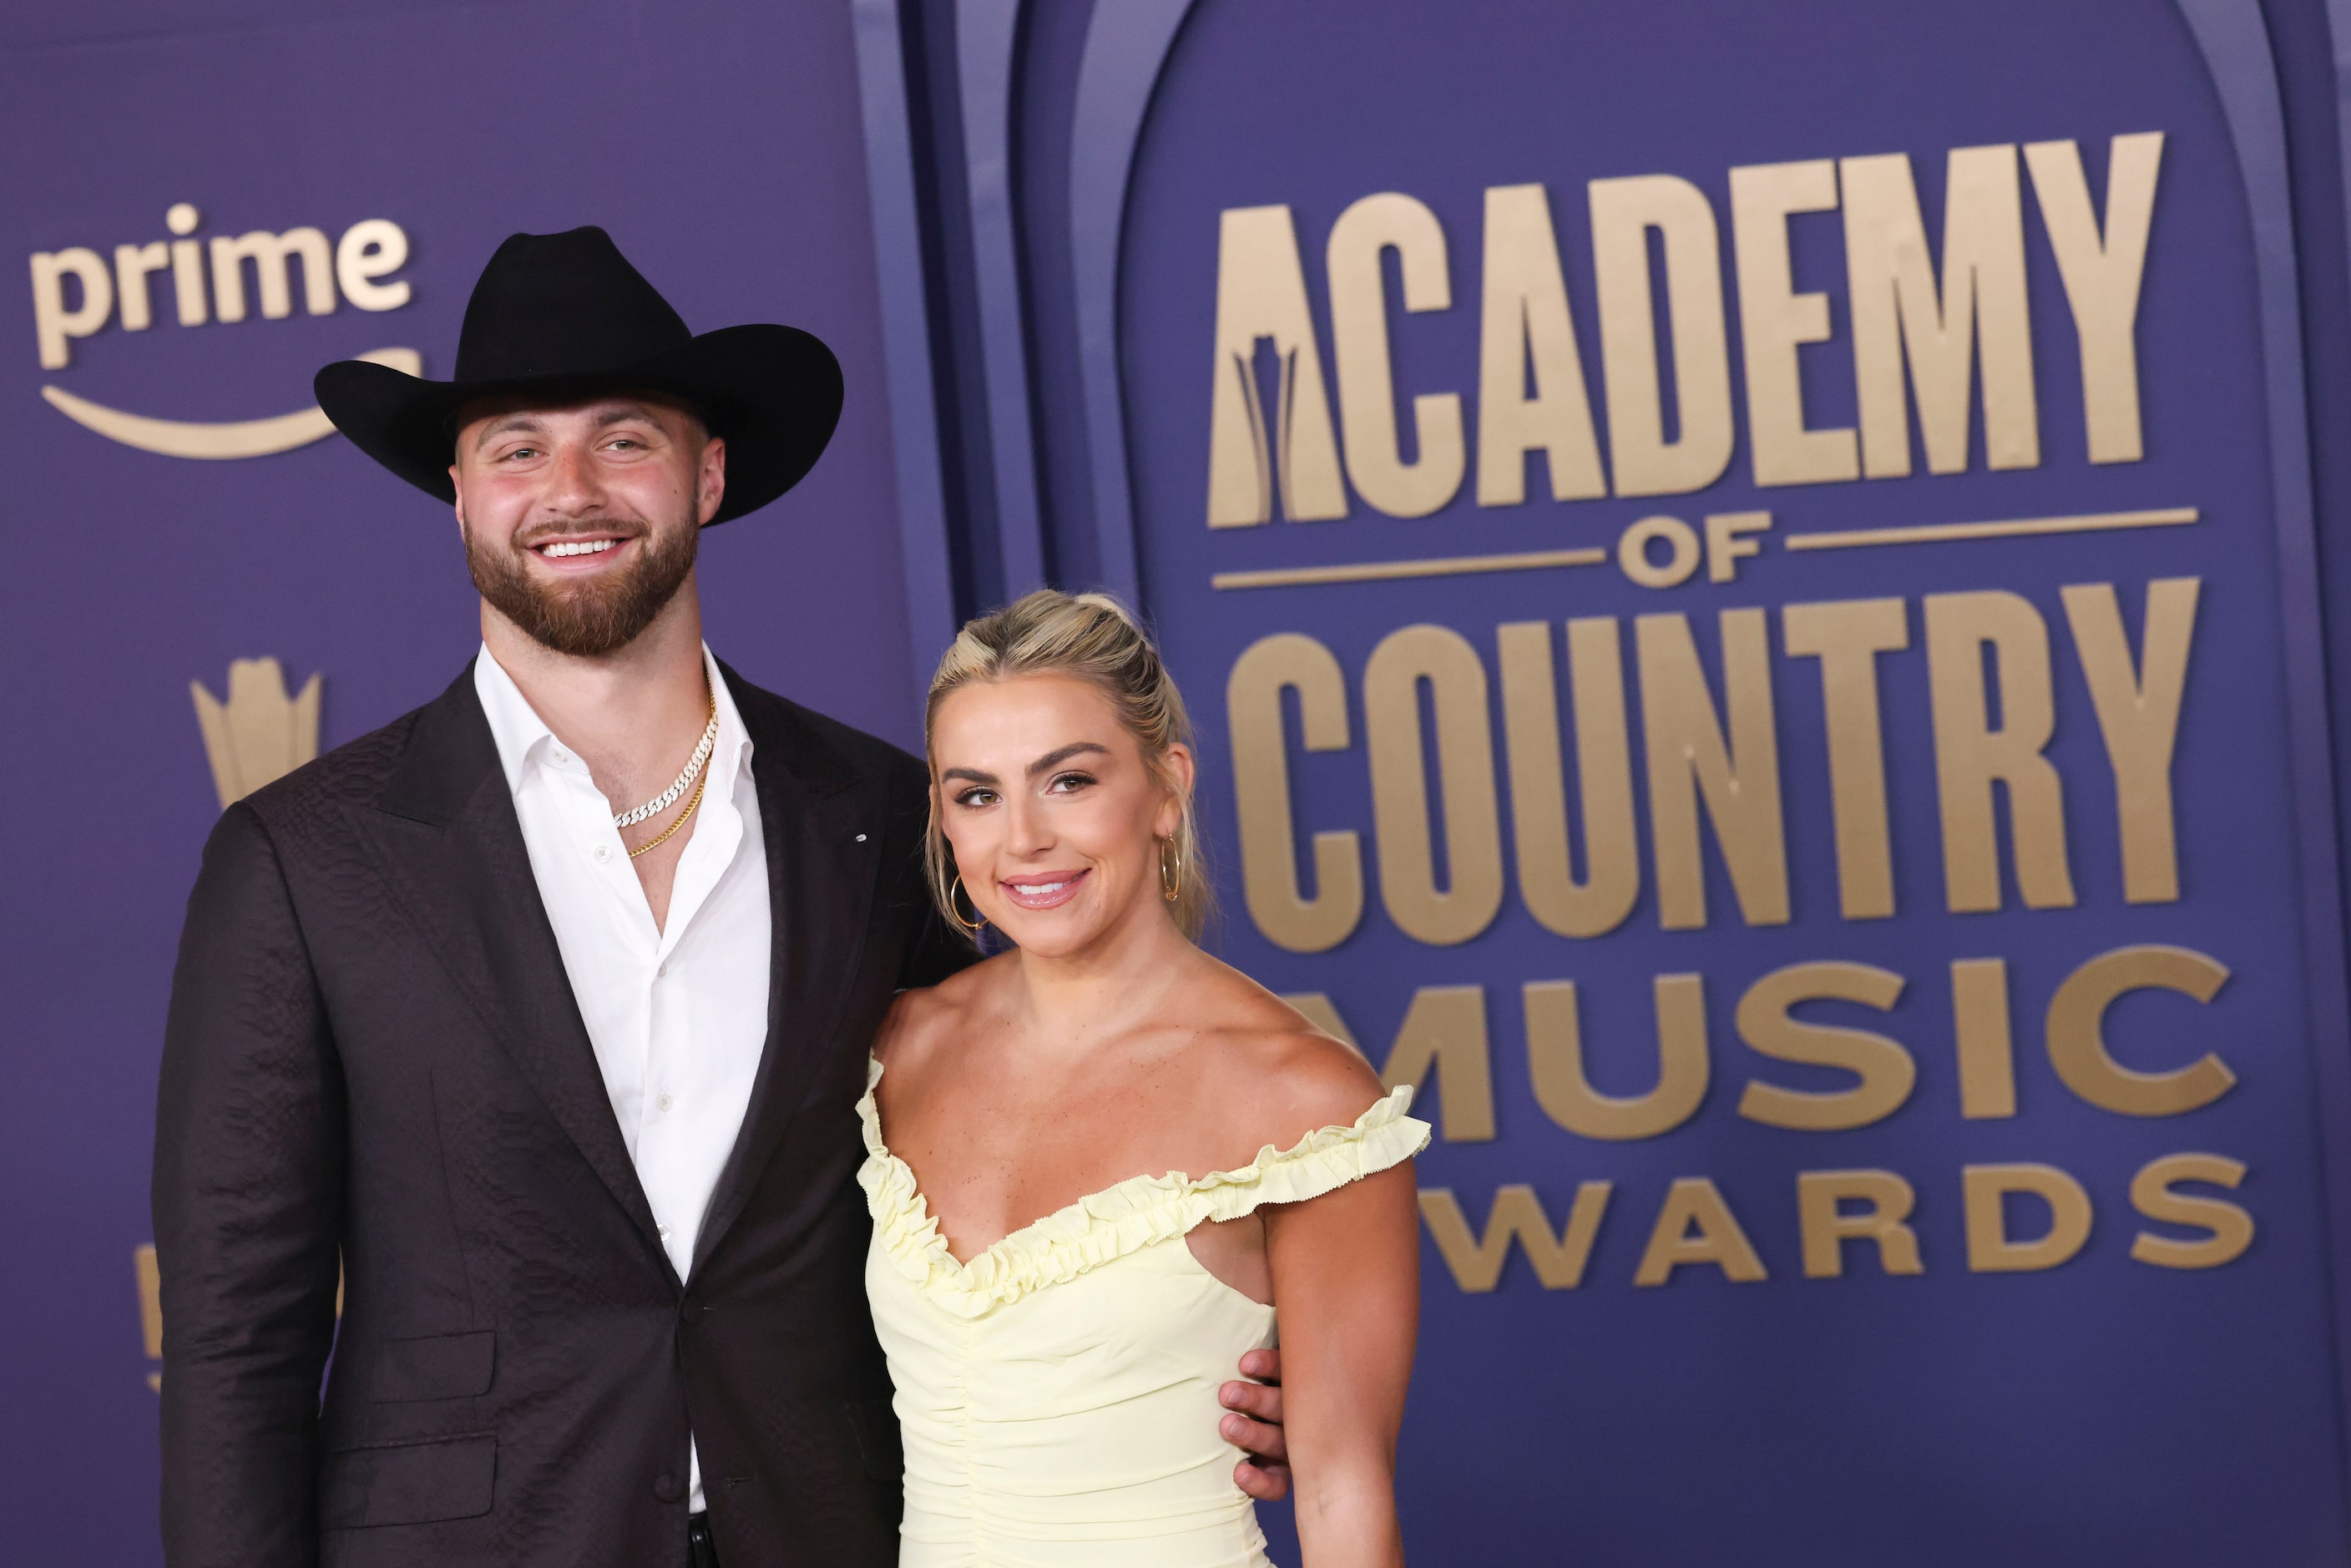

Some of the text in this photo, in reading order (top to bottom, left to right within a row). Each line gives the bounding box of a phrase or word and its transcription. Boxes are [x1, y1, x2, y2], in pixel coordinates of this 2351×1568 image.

[30, 203, 412, 369] prime
[1207, 131, 2164, 529] ACADEMY
[1618, 510, 1772, 589] OF
[1227, 577, 2201, 953] COUNTRY
[1417, 1153, 2255, 1292] WARDS
